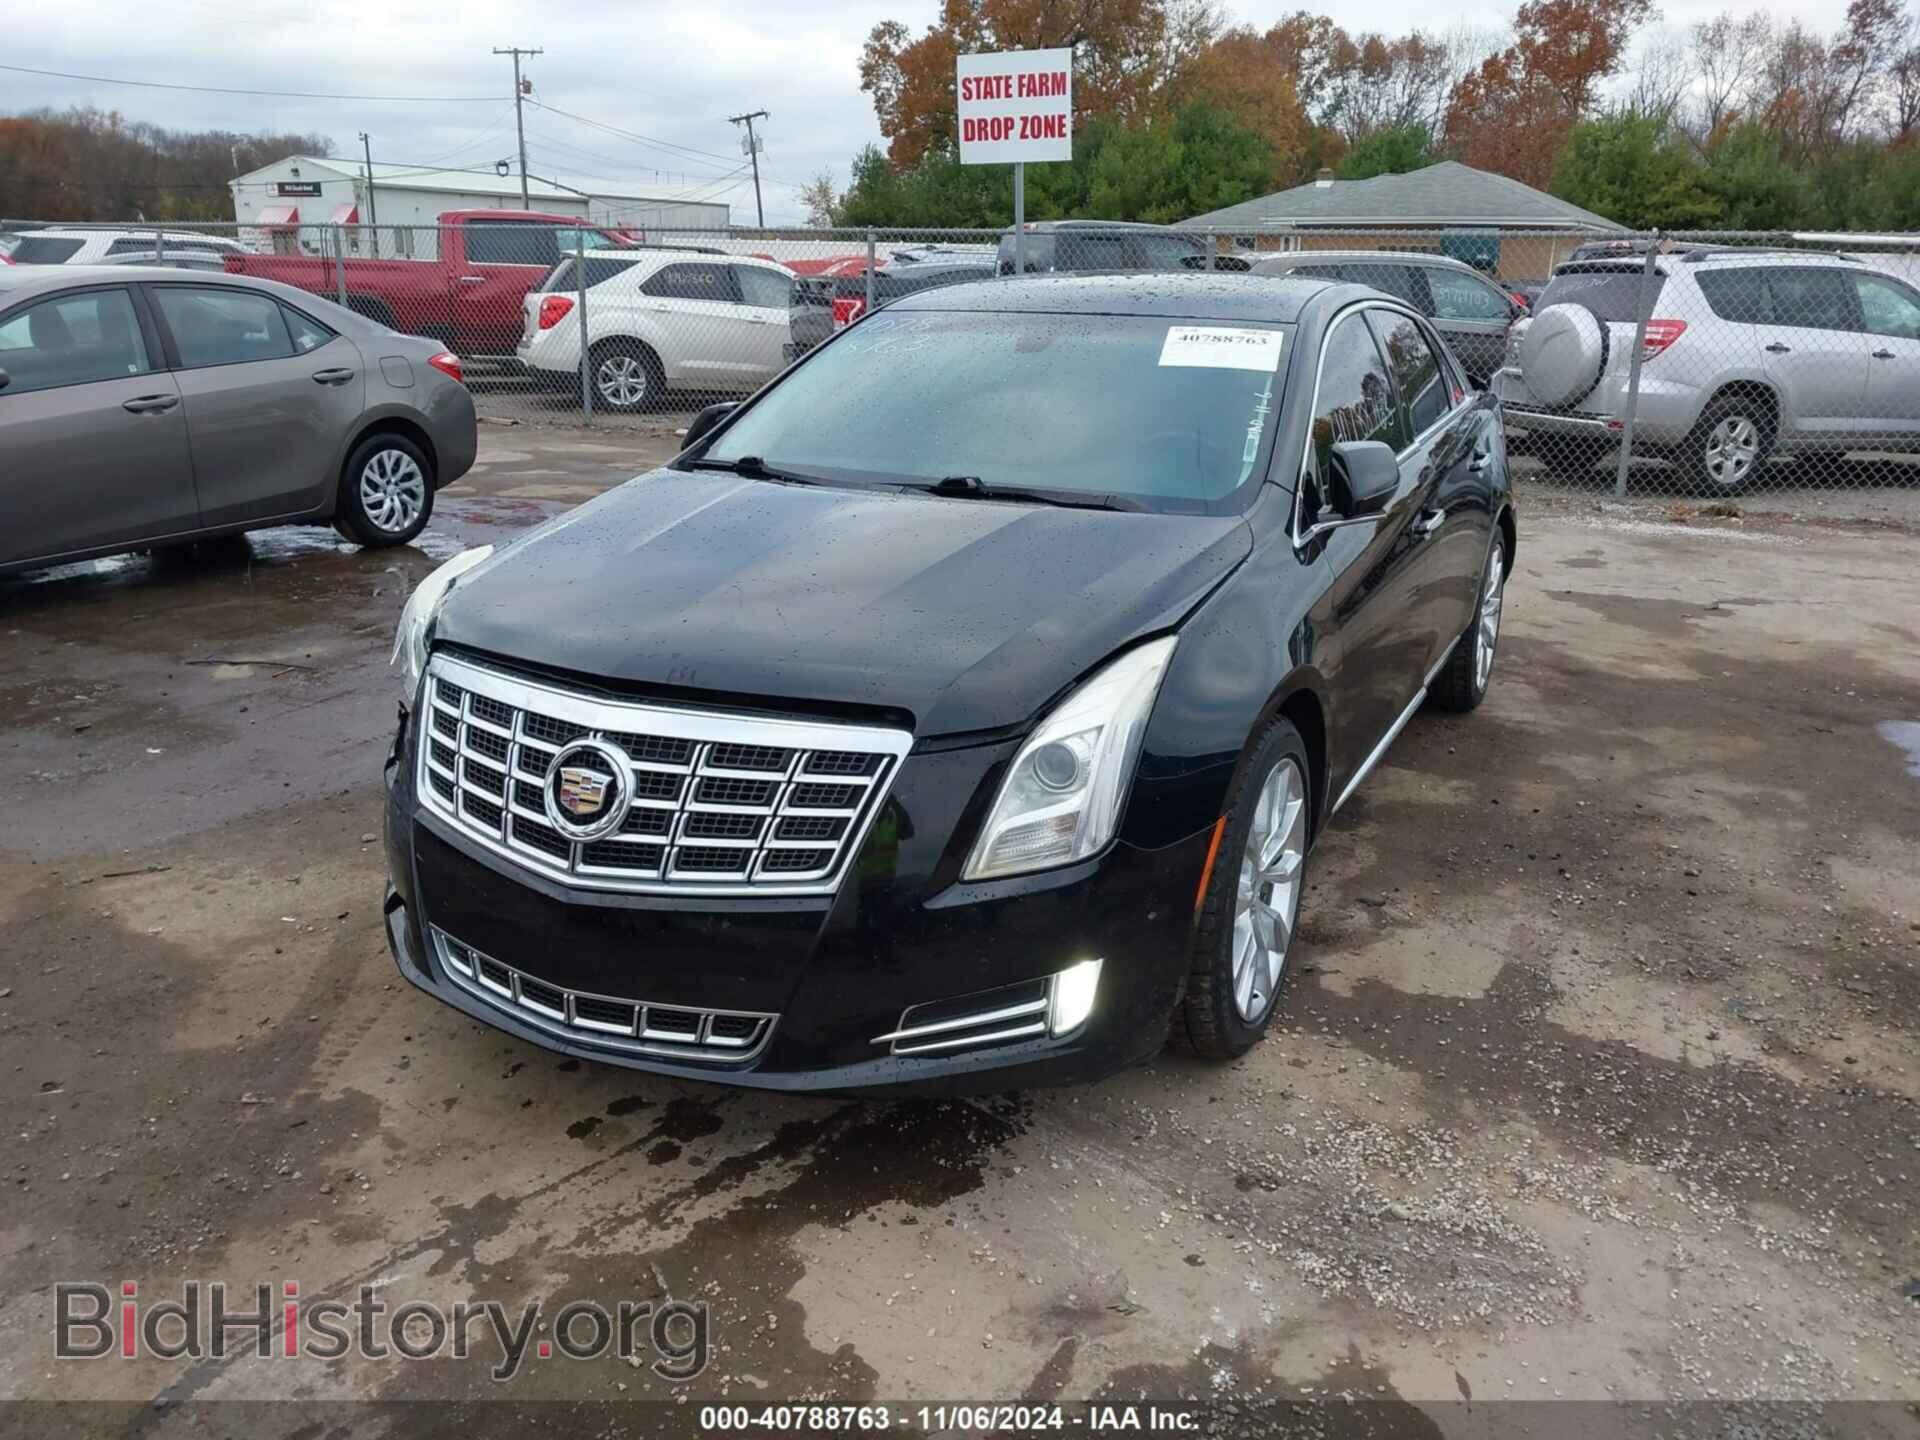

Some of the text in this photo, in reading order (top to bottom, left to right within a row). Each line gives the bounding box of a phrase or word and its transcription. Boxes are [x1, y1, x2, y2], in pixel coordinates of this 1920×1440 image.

[961, 71, 1067, 101] STATE FARM
[963, 114, 1067, 142] DROP ZONE
[1178, 333, 1268, 345] 40788763
